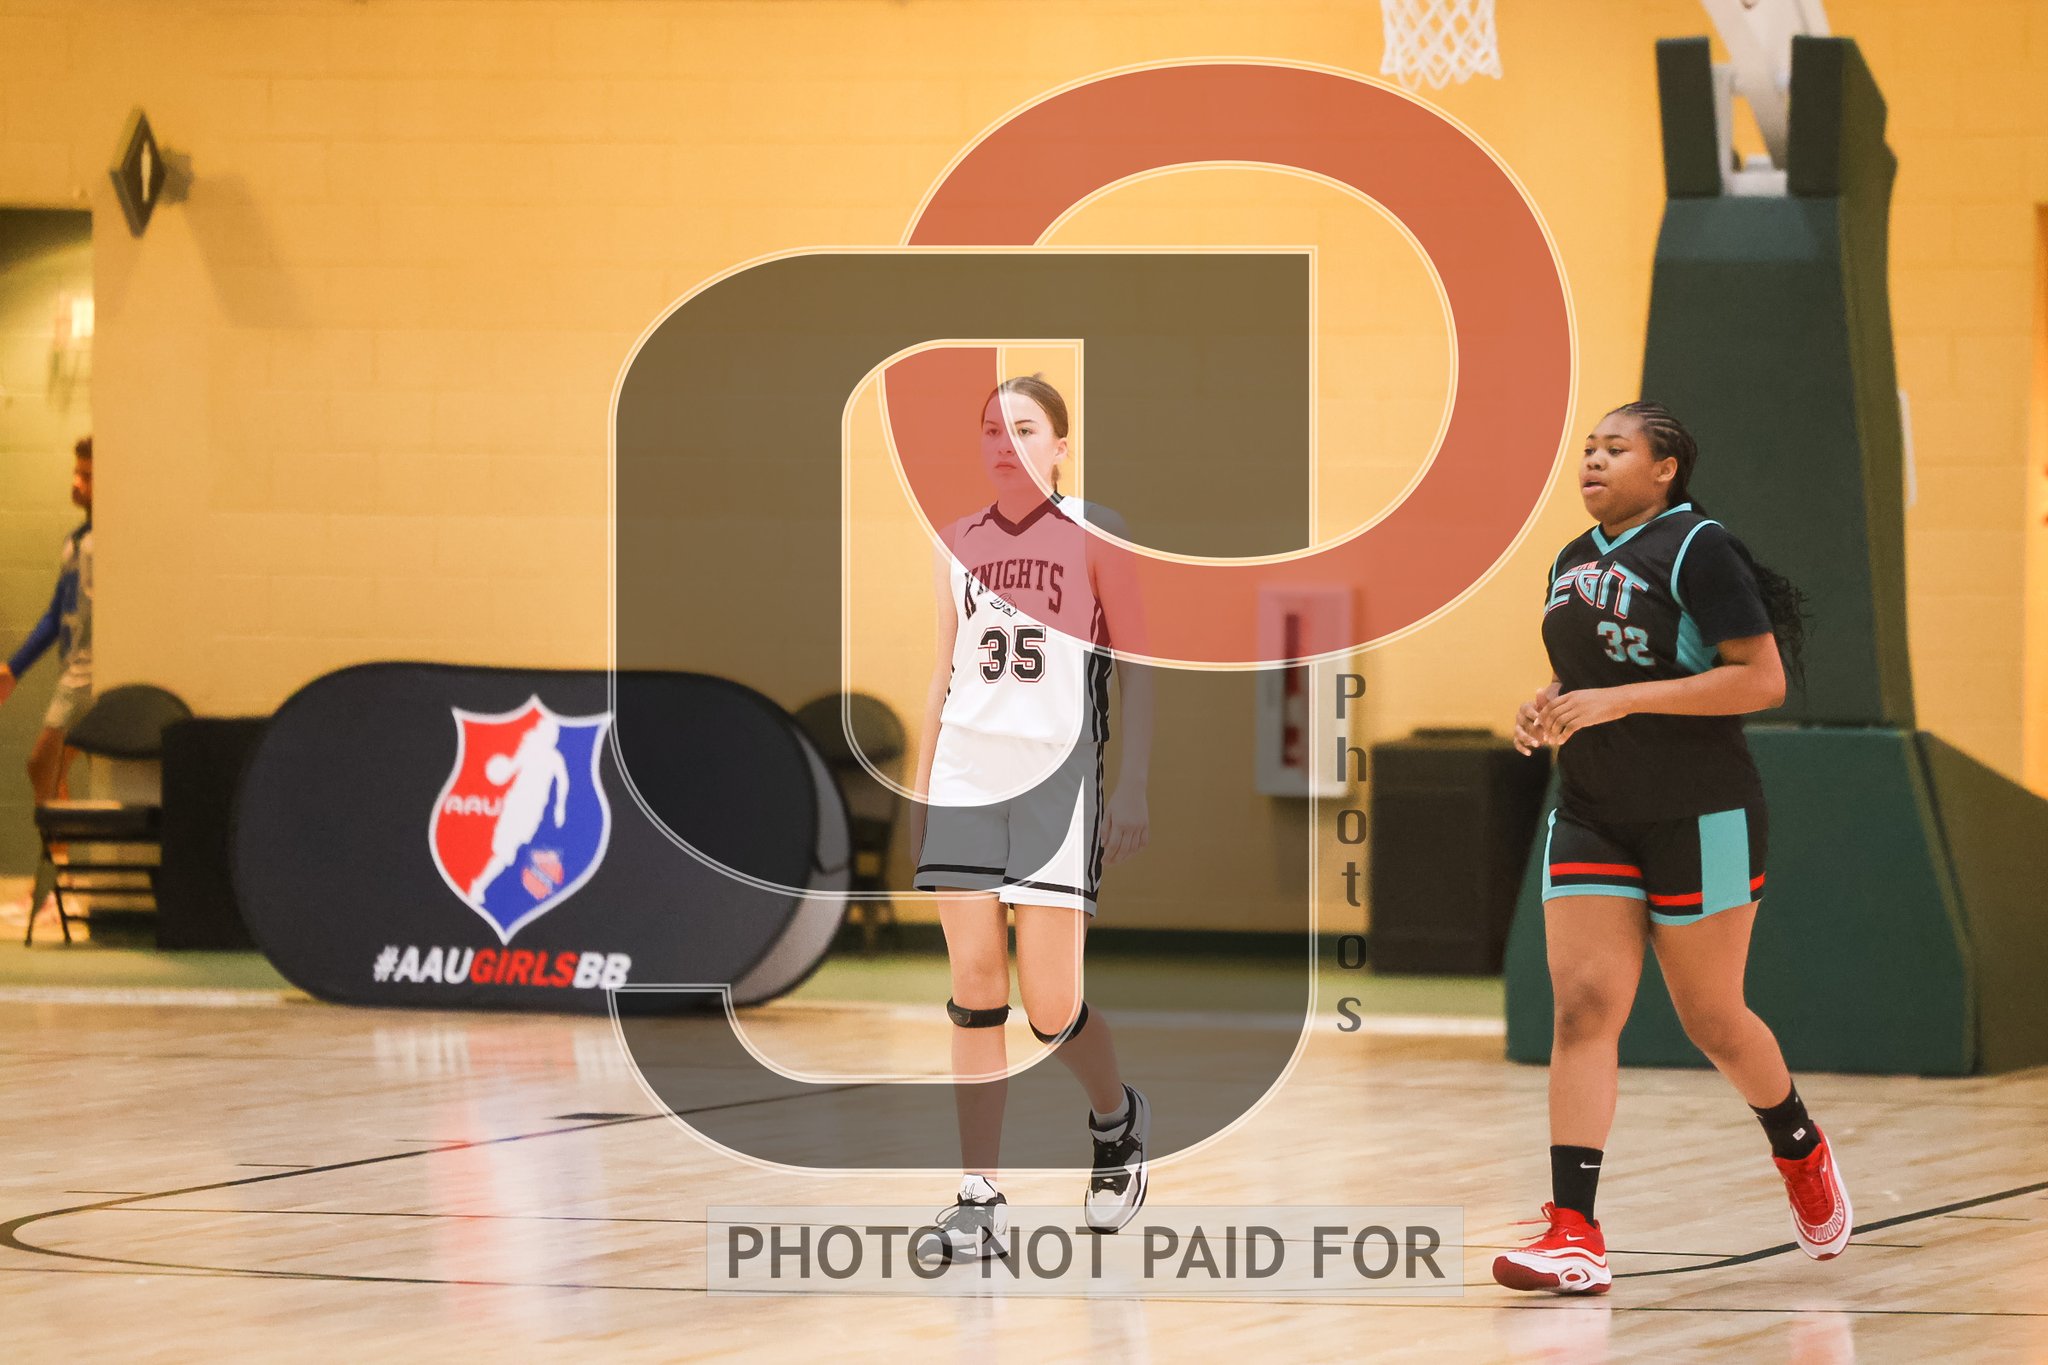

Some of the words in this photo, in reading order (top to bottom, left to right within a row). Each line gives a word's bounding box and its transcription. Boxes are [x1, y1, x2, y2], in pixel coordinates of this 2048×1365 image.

[964, 558, 1064, 620] KNIGHTS
[1544, 561, 1650, 619] EGIT
[978, 625, 1047, 684] 35
[1597, 621, 1655, 666] 32
[445, 795, 504, 817] AAU
[373, 944, 632, 989] #AAUGIRLSBB
